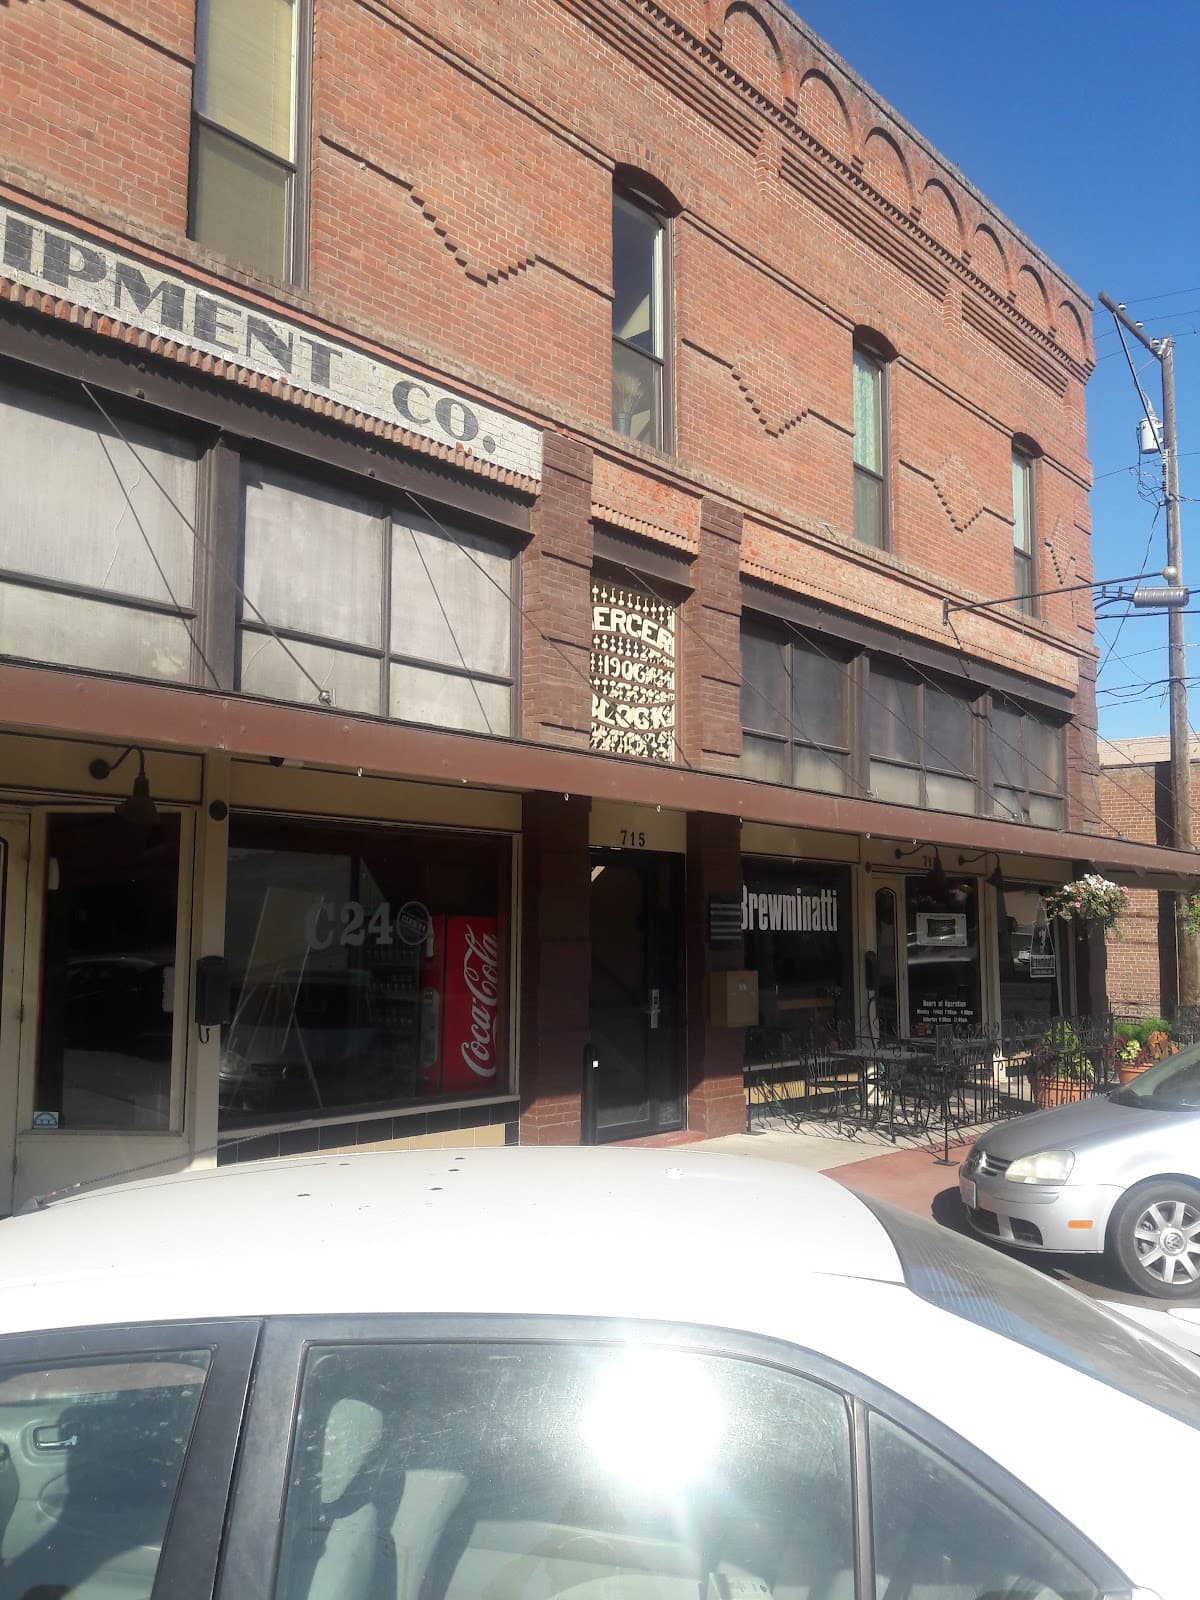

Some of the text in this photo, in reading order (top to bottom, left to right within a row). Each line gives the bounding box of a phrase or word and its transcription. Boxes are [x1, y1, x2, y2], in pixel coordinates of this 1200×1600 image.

[3, 215, 496, 454] IPMENT CO.
[592, 606, 675, 653] ERCER
[620, 830, 645, 847] 715
[741, 885, 838, 931] Brewminatti
[461, 924, 497, 1077] Coca-Cola
